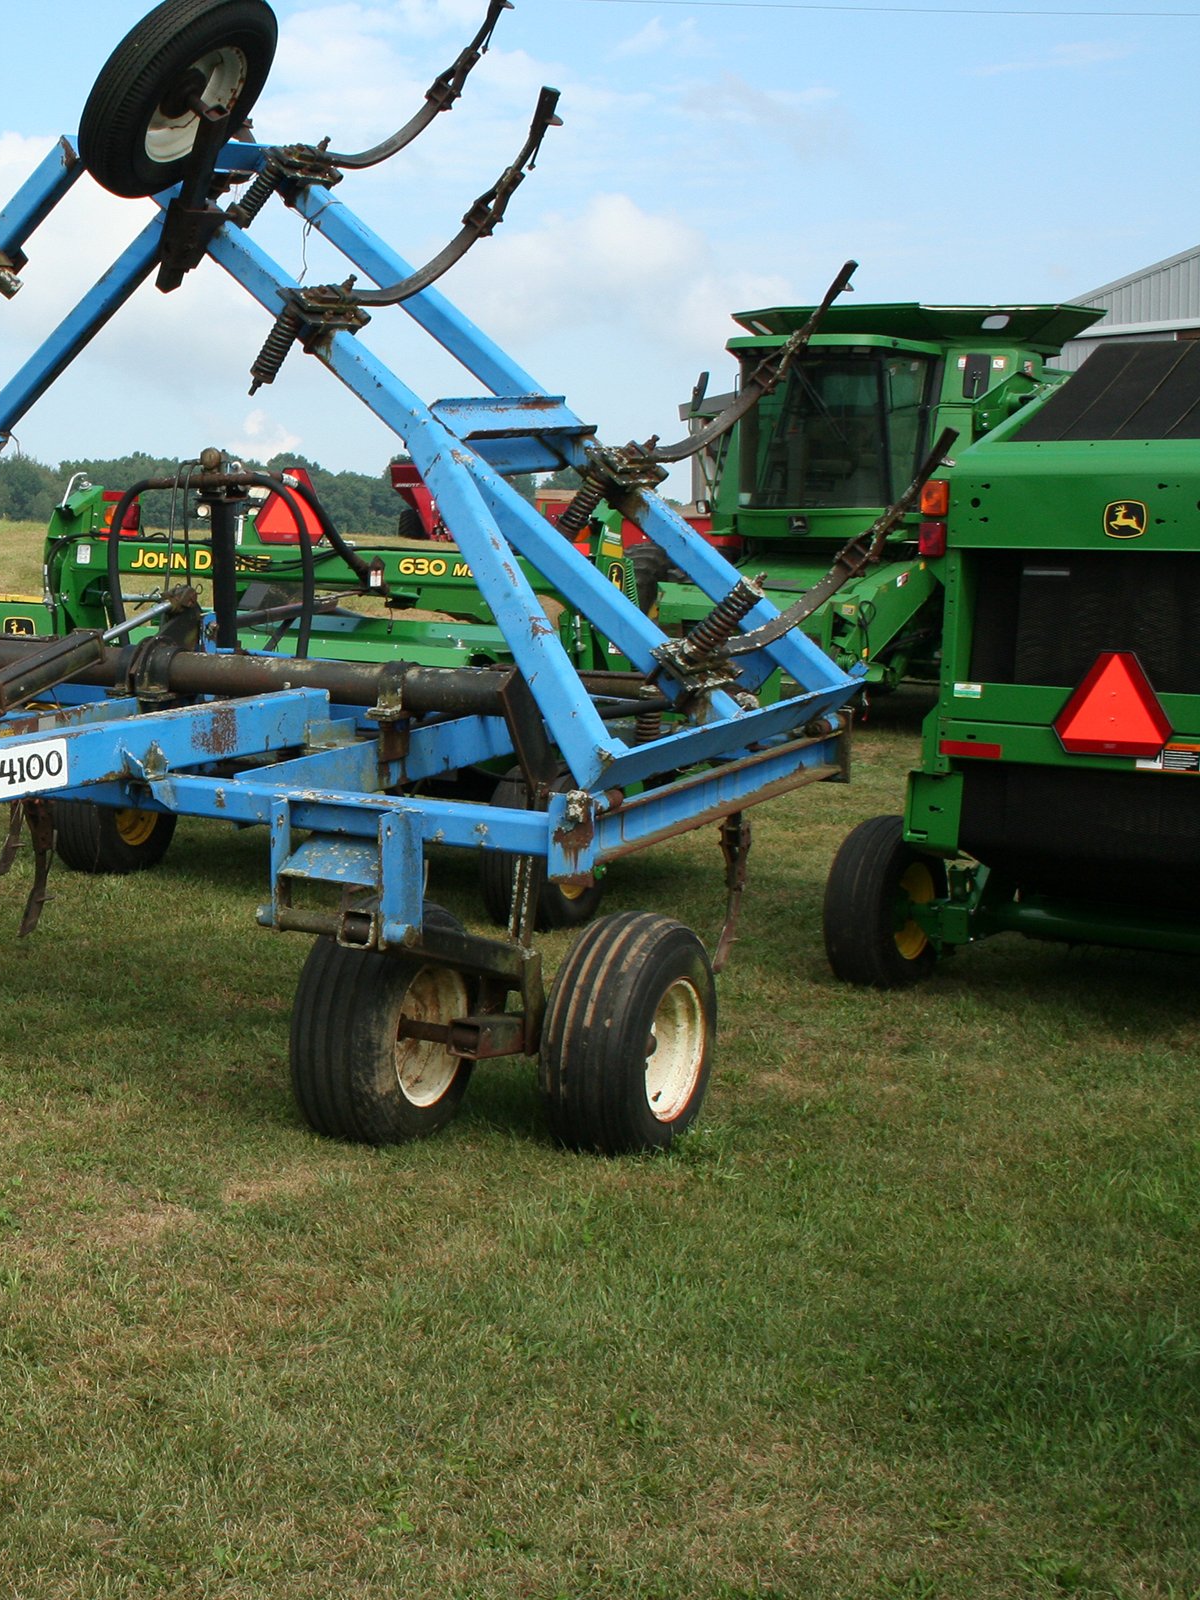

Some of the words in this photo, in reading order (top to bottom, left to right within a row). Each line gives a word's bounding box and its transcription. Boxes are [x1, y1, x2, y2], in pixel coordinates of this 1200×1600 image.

[131, 549, 187, 569] JOHN
[399, 558, 447, 576] 630
[0, 750, 63, 785] 4100
